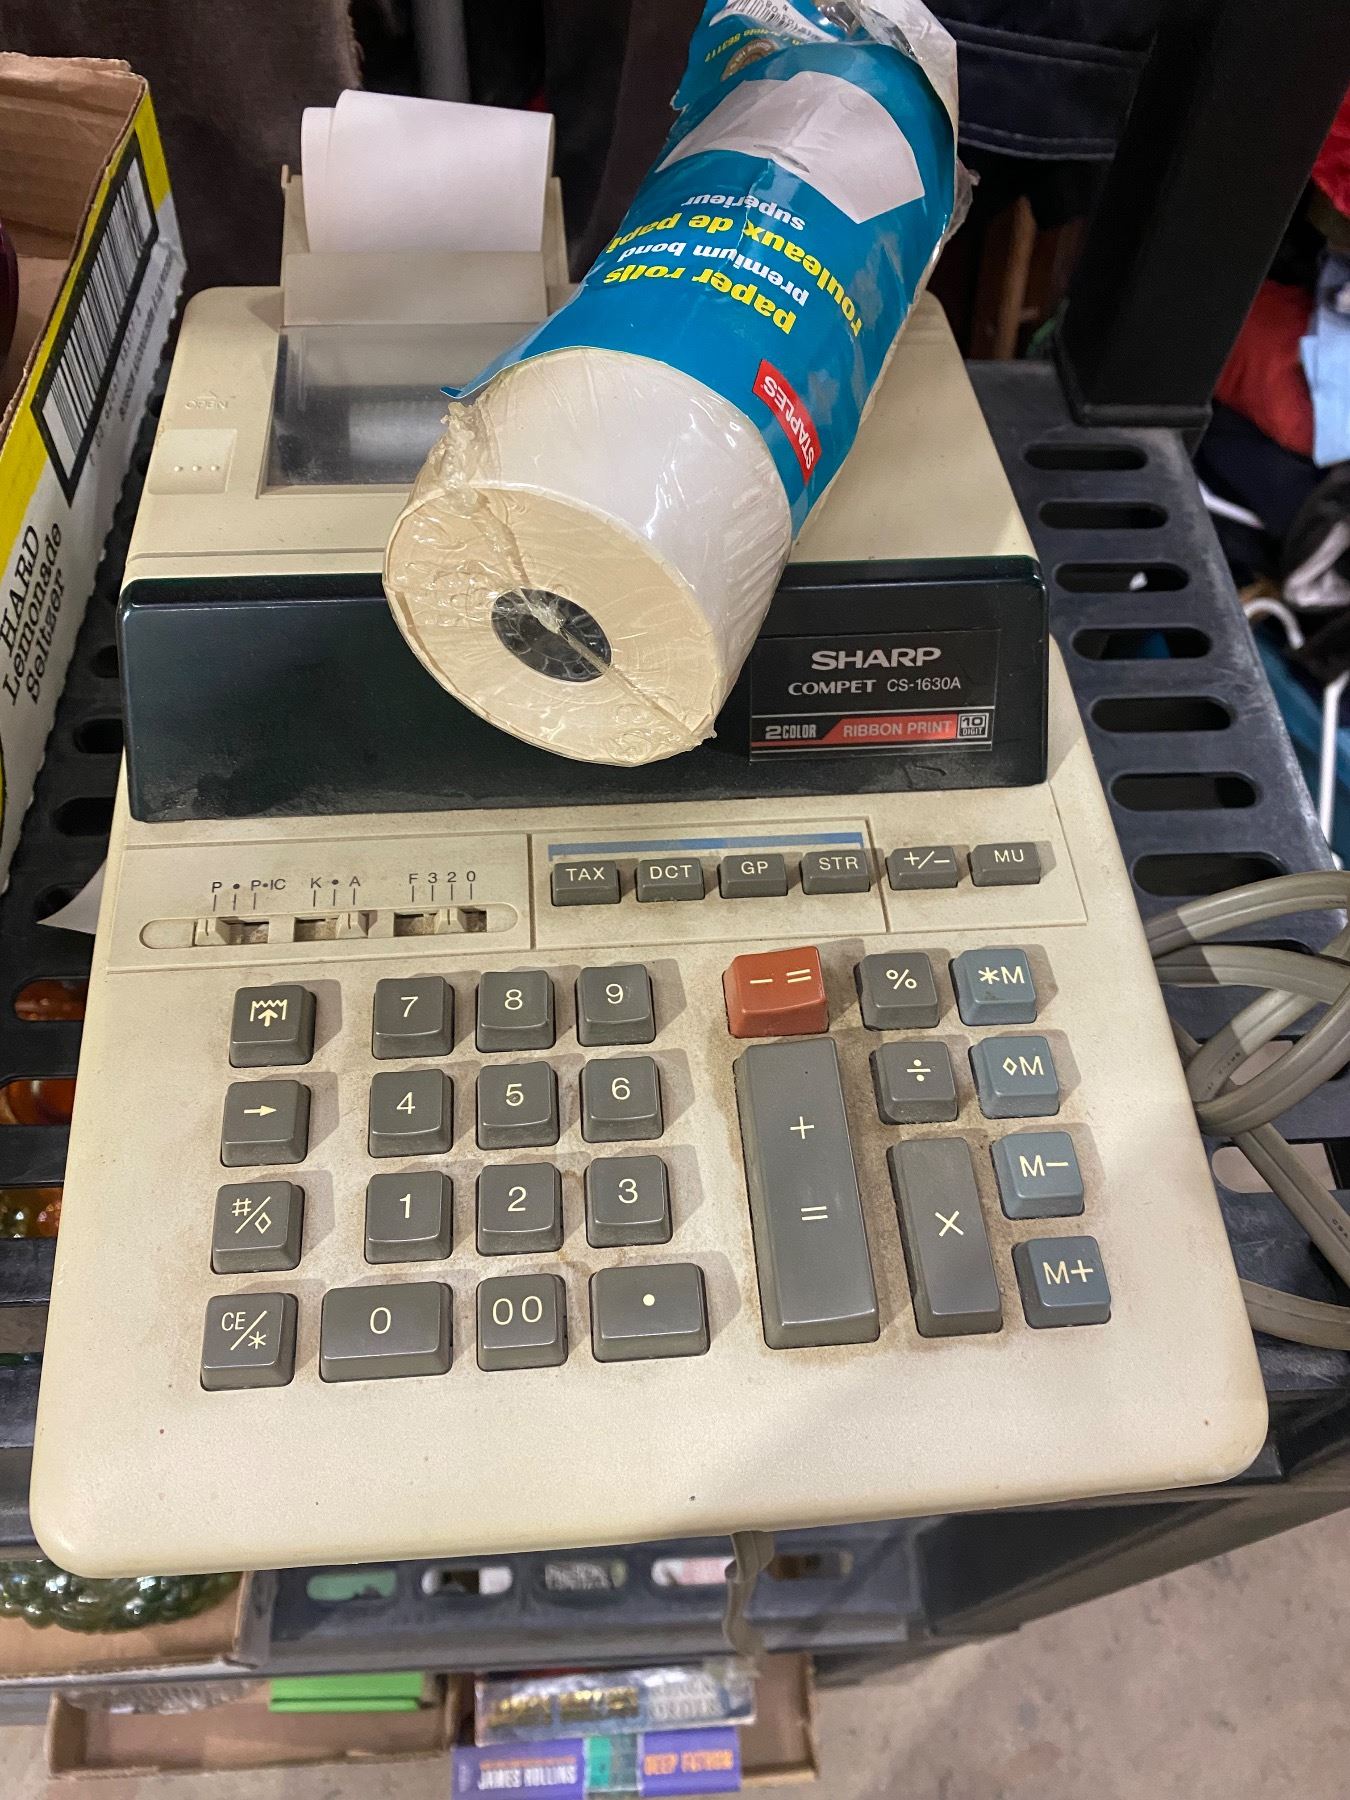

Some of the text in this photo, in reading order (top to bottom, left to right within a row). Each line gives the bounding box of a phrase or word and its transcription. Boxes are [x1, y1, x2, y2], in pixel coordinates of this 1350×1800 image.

[688, 214, 734, 234] de
[617, 241, 810, 307] premium bond
[743, 218, 862, 337] rouleaux
[603, 264, 797, 335] paper rolls
[763, 375, 815, 470] STAPLES
[0, 525, 40, 658] HARD
[3, 523, 62, 706] Lemonade
[811, 647, 942, 671] SHARP
[787, 677, 961, 696] COMPET CS-1630A
[843, 722, 903, 738] RIBBON
[907, 720, 952, 735] PRINT
[962, 715, 984, 728] 10
[962, 727, 985, 737] DIGIT
[818, 856, 860, 872] STR
[994, 848, 1026, 864] MU
[427, 872, 438, 883] 3
[447, 871, 458, 883] 2
[565, 865, 606, 882] TAX
[649, 863, 693, 880] DCT
[740, 860, 770, 876] GP
[211, 881, 223, 893] P
[310, 875, 362, 889] K A
[885, 968, 918, 990] %
[504, 988, 523, 1010] 8
[605, 983, 625, 1004] 9
[399, 995, 419, 1018] 7
[505, 1083, 525, 1106] 5
[611, 1077, 631, 1100] 6
[396, 1091, 416, 1115] 4
[507, 1186, 527, 1212] 2
[618, 1178, 638, 1204] 3
[399, 1193, 413, 1220] 1
[1042, 1259, 1094, 1286] M+
[369, 1306, 392, 1334] 0
[492, 1295, 544, 1325] 00
